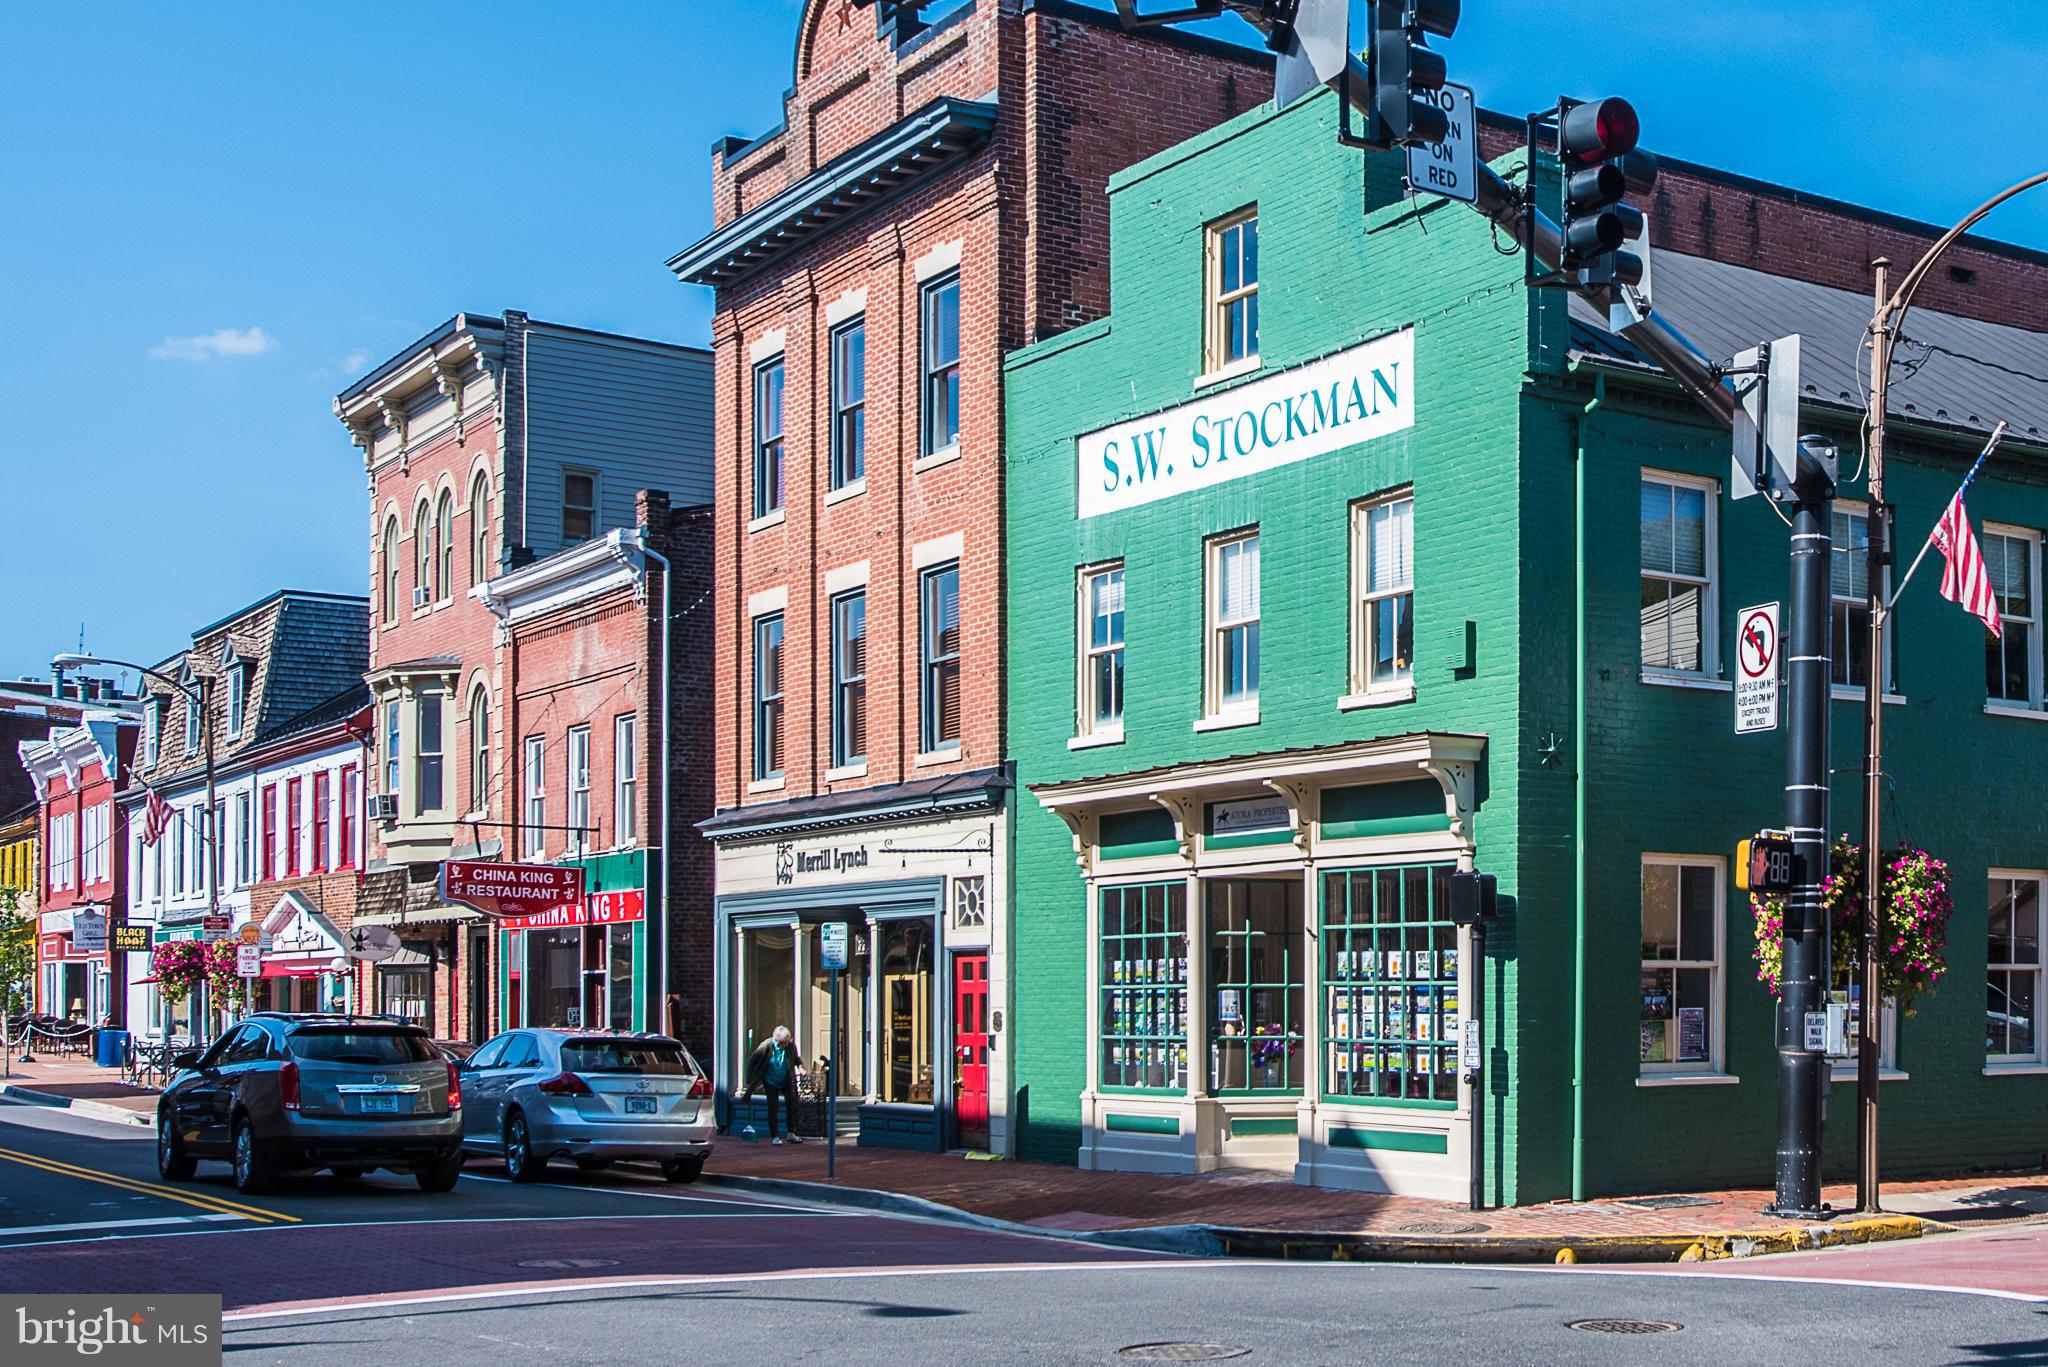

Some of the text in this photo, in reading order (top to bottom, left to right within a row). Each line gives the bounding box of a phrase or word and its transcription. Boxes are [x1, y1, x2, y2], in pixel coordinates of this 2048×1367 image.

[1425, 88, 1455, 112] NO
[1432, 143, 1453, 163] ON
[1429, 165, 1457, 188] RED
[1103, 362, 1400, 492] S.W. STOCKMAN
[797, 845, 868, 873] Merrill Lynch
[473, 868, 517, 882] CHINA
[520, 871, 554, 884] KING
[466, 884, 559, 900] RESTAURANT
[116, 928, 146, 937] BLACK
[1807, 1018, 1825, 1026] DELAYED
[1811, 1028, 1821, 1036] WALK
[1809, 1037, 1823, 1046] SIGNAL
